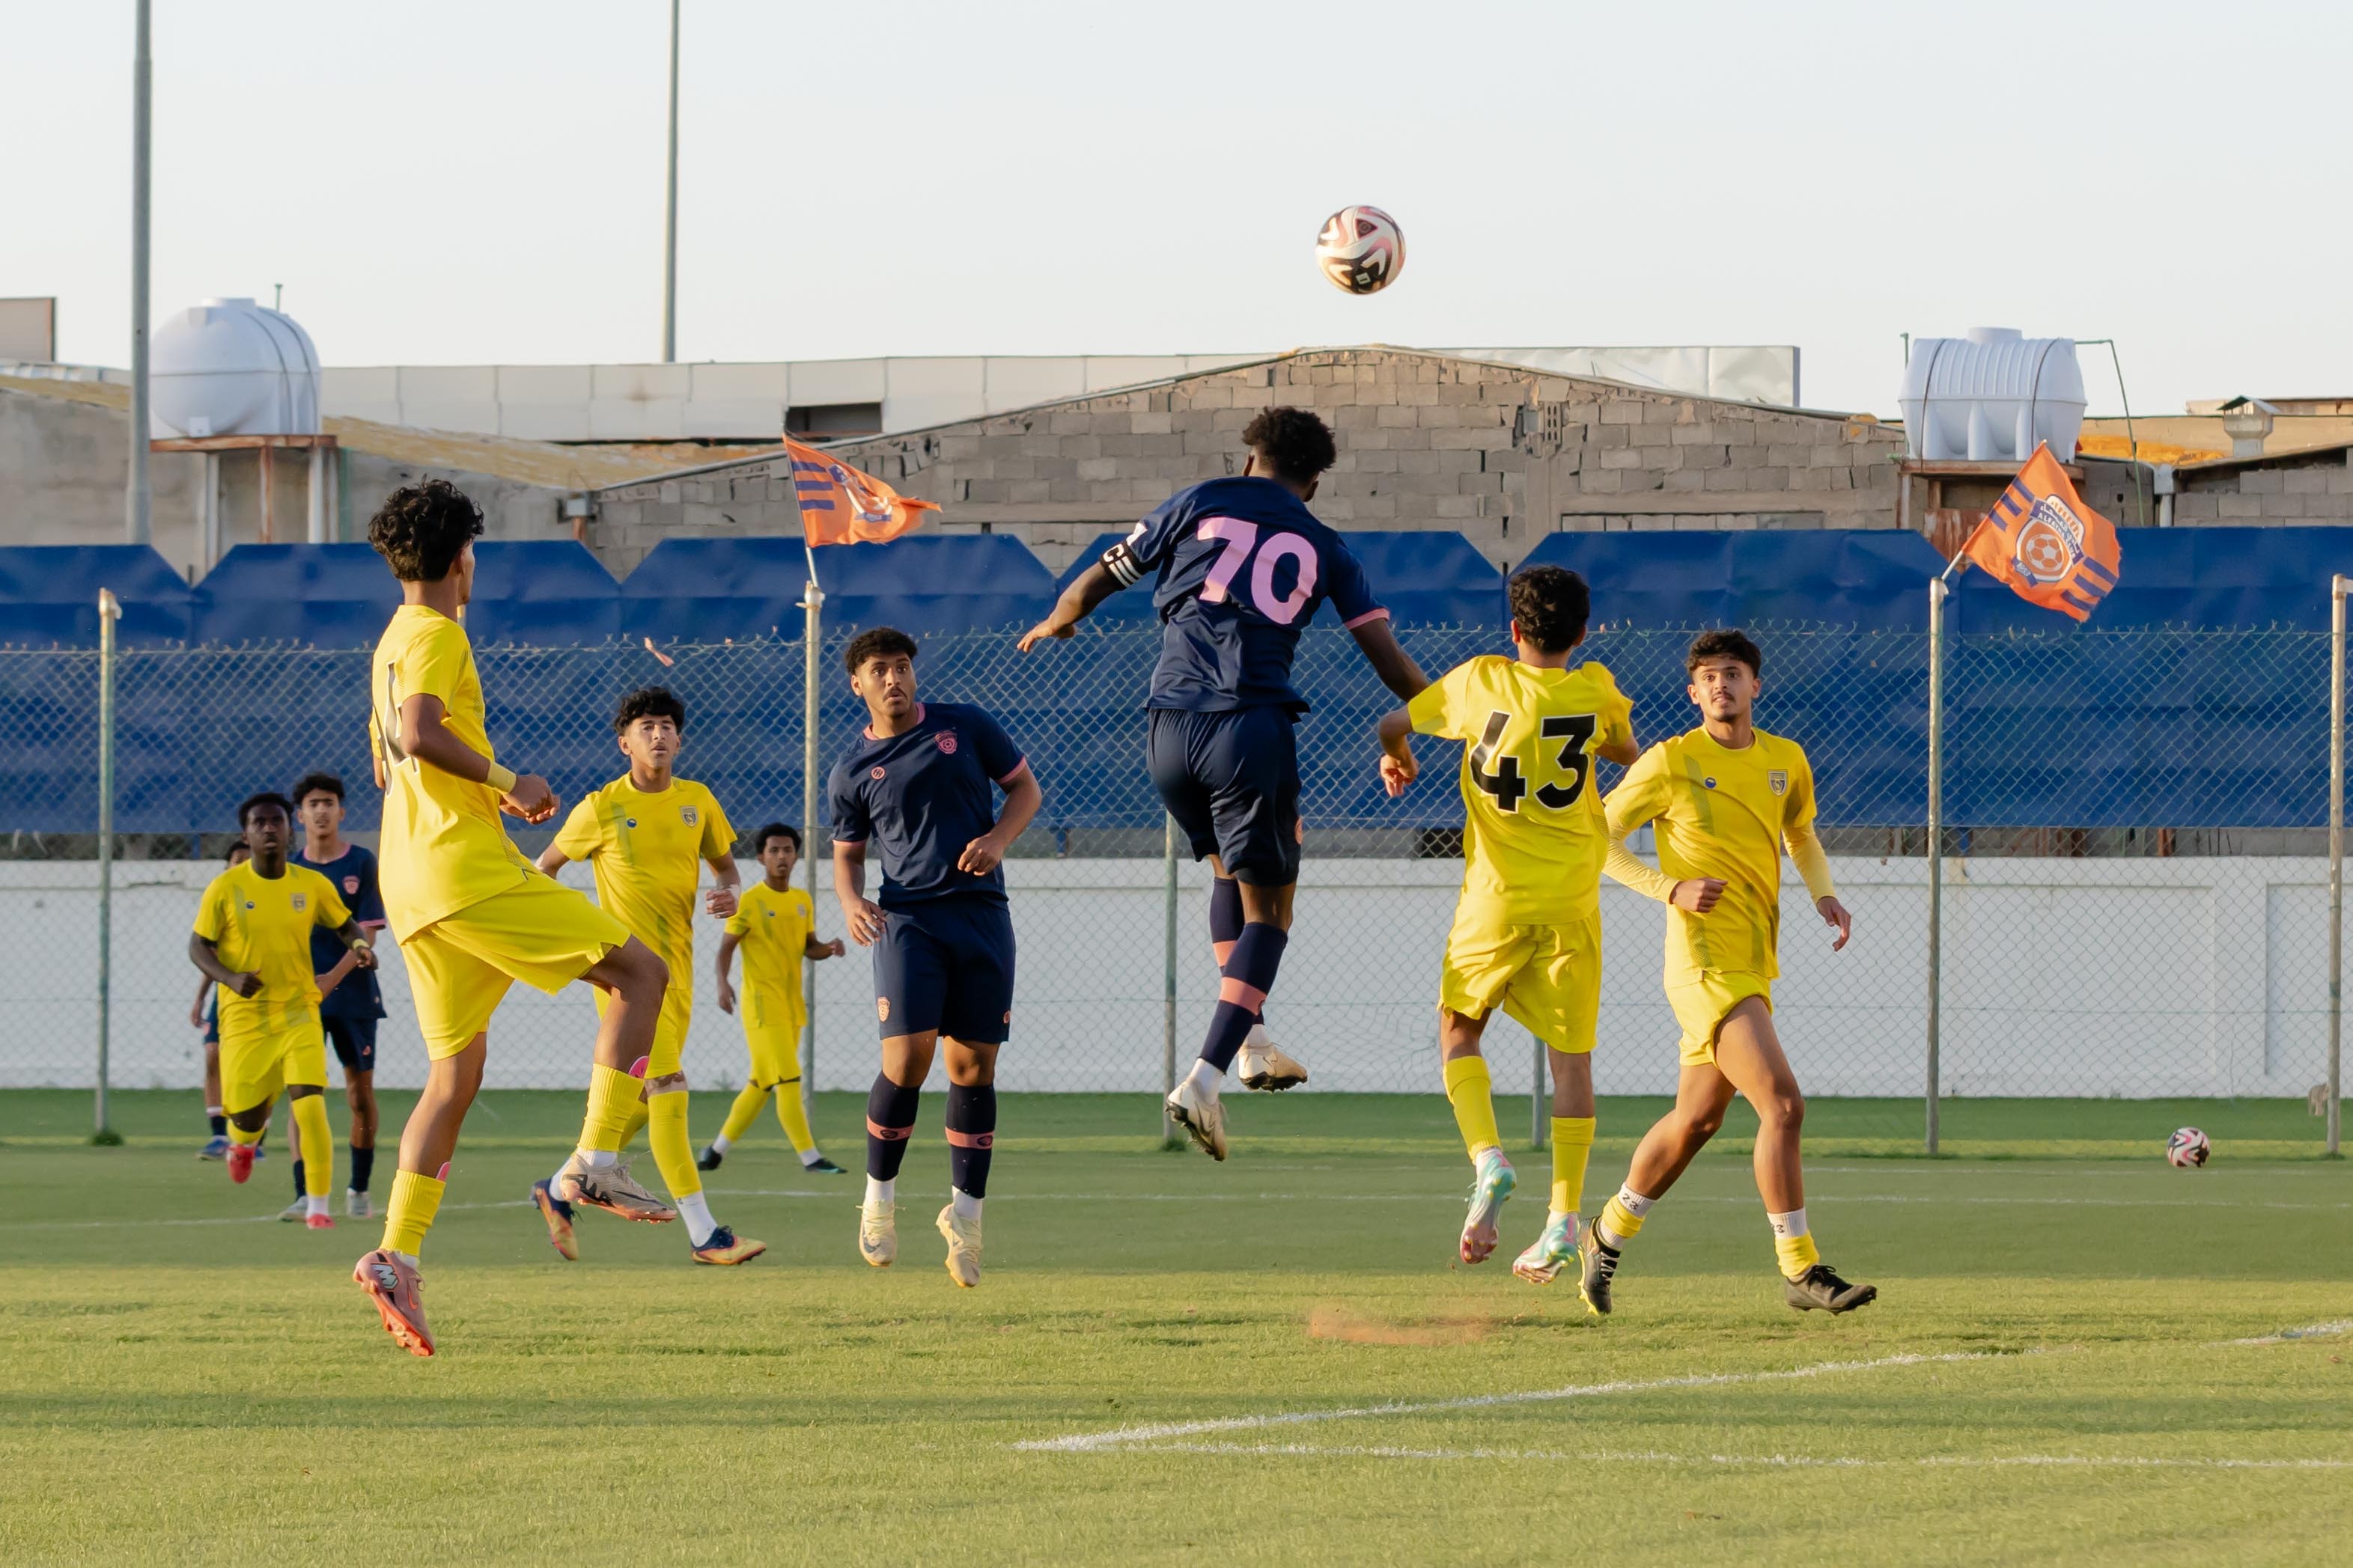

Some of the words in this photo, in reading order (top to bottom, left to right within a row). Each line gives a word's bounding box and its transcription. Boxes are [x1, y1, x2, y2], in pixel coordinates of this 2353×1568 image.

[1103, 543, 1124, 563] C
[1197, 516, 1318, 624] 70
[1470, 710, 1597, 814] 43
